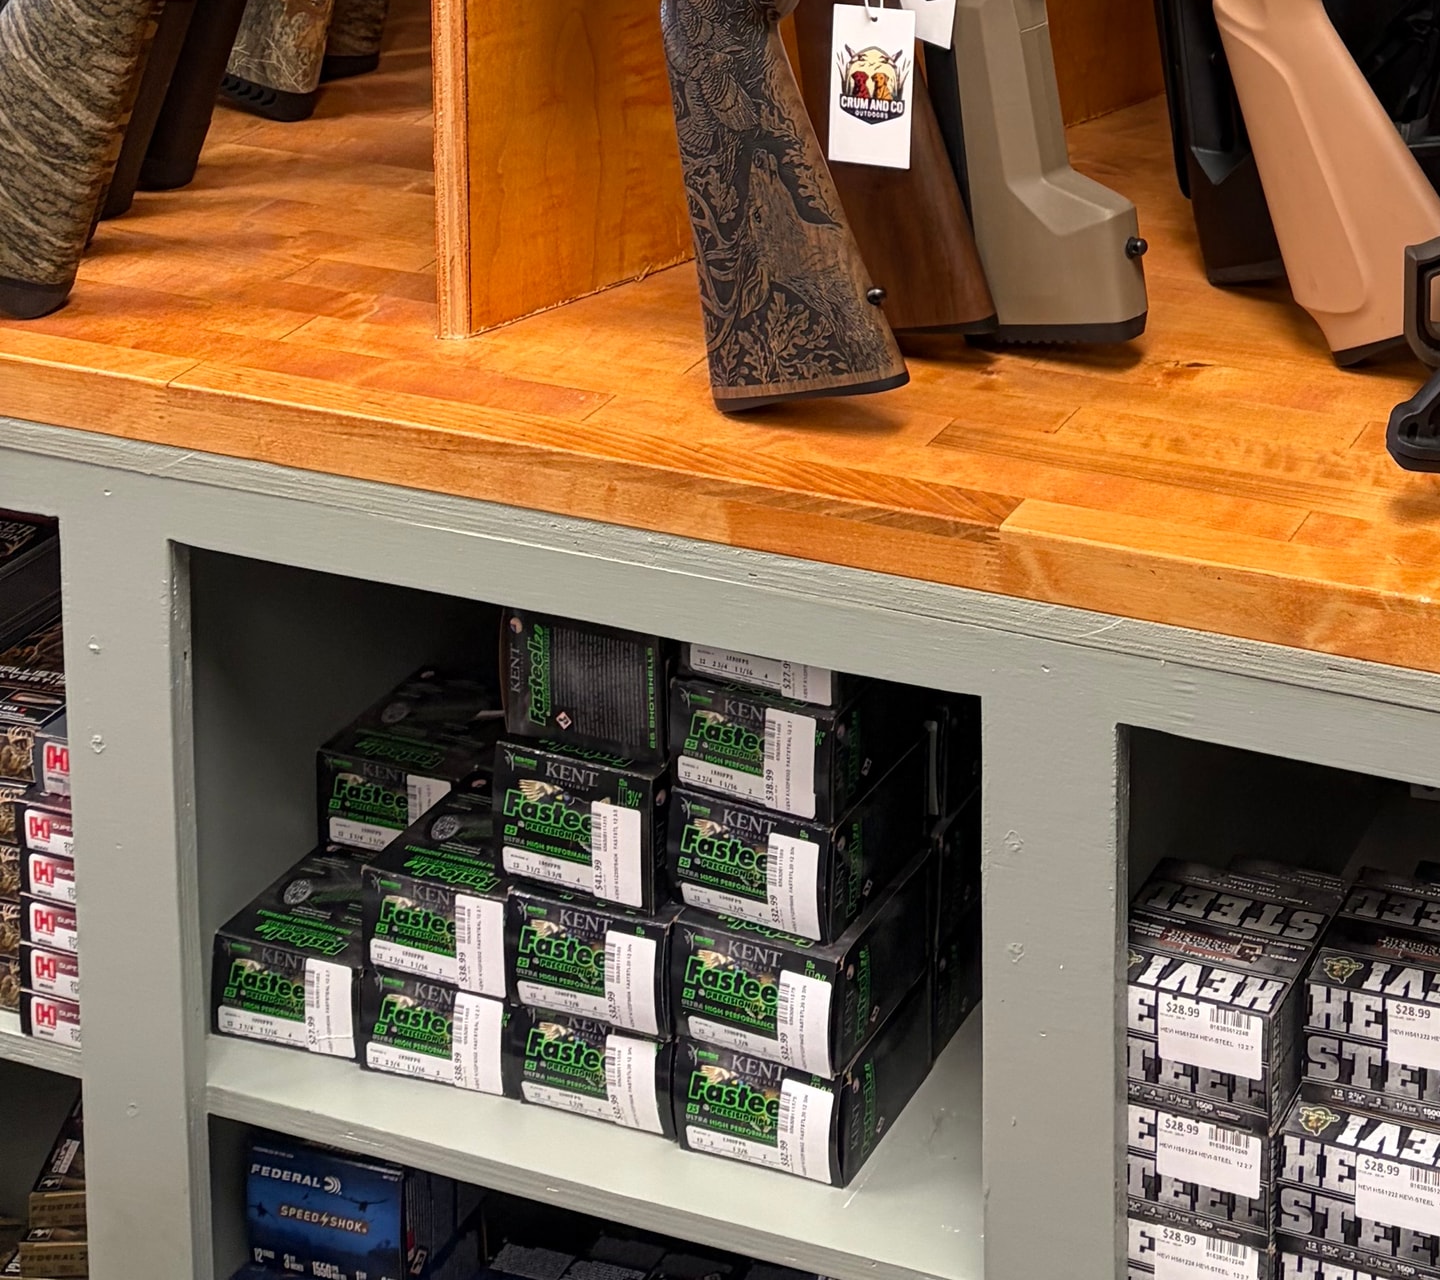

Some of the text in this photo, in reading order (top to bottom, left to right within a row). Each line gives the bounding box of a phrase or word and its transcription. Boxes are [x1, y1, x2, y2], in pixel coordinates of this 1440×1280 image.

[840, 96, 903, 114] CRUM AND CO
[855, 110, 888, 119] OUTDOORS
[510, 642, 521, 693] KENT
[724, 700, 765, 719] KEN
[705, 754, 723, 767] HIGH
[709, 744, 750, 760] PRECISION
[545, 761, 600, 788] KENT
[766, 769, 775, 802] $38.99
[525, 821, 573, 843] PRECISION
[722, 808, 778, 836] KENT
[526, 840, 544, 850] HIGH
[680, 824, 768, 874] Fastee
[700, 872, 718, 884] HIGH
[701, 859, 747, 882] PRECISION
[412, 884, 450, 902] KEN
[379, 901, 456, 934] Fastee
[559, 909, 613, 934] KENT
[770, 894, 780, 924] $32.99
[1146, 881, 1324, 941] STEEL
[262, 948, 306, 971] KENT
[519, 925, 606, 971] Fastee
[728, 940, 783, 968] KENT
[459, 952, 468, 983] $38.99
[538, 973, 558, 983] HIGH
[684, 956, 778, 1004] Fastee
[228, 961, 305, 1000] Fastee
[414, 982, 453, 1004] KEN
[1137, 954, 1285, 1011] HEVI
[608, 991, 619, 1020] $32.99
[705, 991, 750, 1010] PRECISION
[1166, 1001, 1200, 1018] $28.99
[1395, 1003, 1431, 1019] $28.99
[379, 998, 453, 1035] Fastee
[704, 1004, 776, 1030] HIGH PERFORMANCE
[524, 1029, 607, 1073] Fastee
[780, 1032, 791, 1062] $32.99
[1200, 1035, 1234, 1048] HEVI-STEEL
[454, 1052, 464, 1082] $38.99
[732, 1054, 788, 1082] KENT
[688, 1071, 778, 1118] Fastee
[1195, 1100, 1213, 1111] 1500
[610, 1094, 624, 1121] $32.99
[710, 1106, 754, 1124] PRECISION
[1423, 1107, 1440, 1118] 1500
[710, 1119, 728, 1130] HIGH
[1165, 1118, 1199, 1135] $28.99
[779, 1140, 791, 1167] $32.99
[1198, 1150, 1232, 1165] HEVI-STEEL
[251, 1163, 321, 1188] FEDERAL
[1364, 1159, 1400, 1176] $28.99
[1399, 1194, 1435, 1207] HEVI-STEEL
[280, 1205, 363, 1233] SPEED SHOK
[1162, 1228, 1197, 1246] $28.99
[254, 1248, 332, 1277] 12 1550
